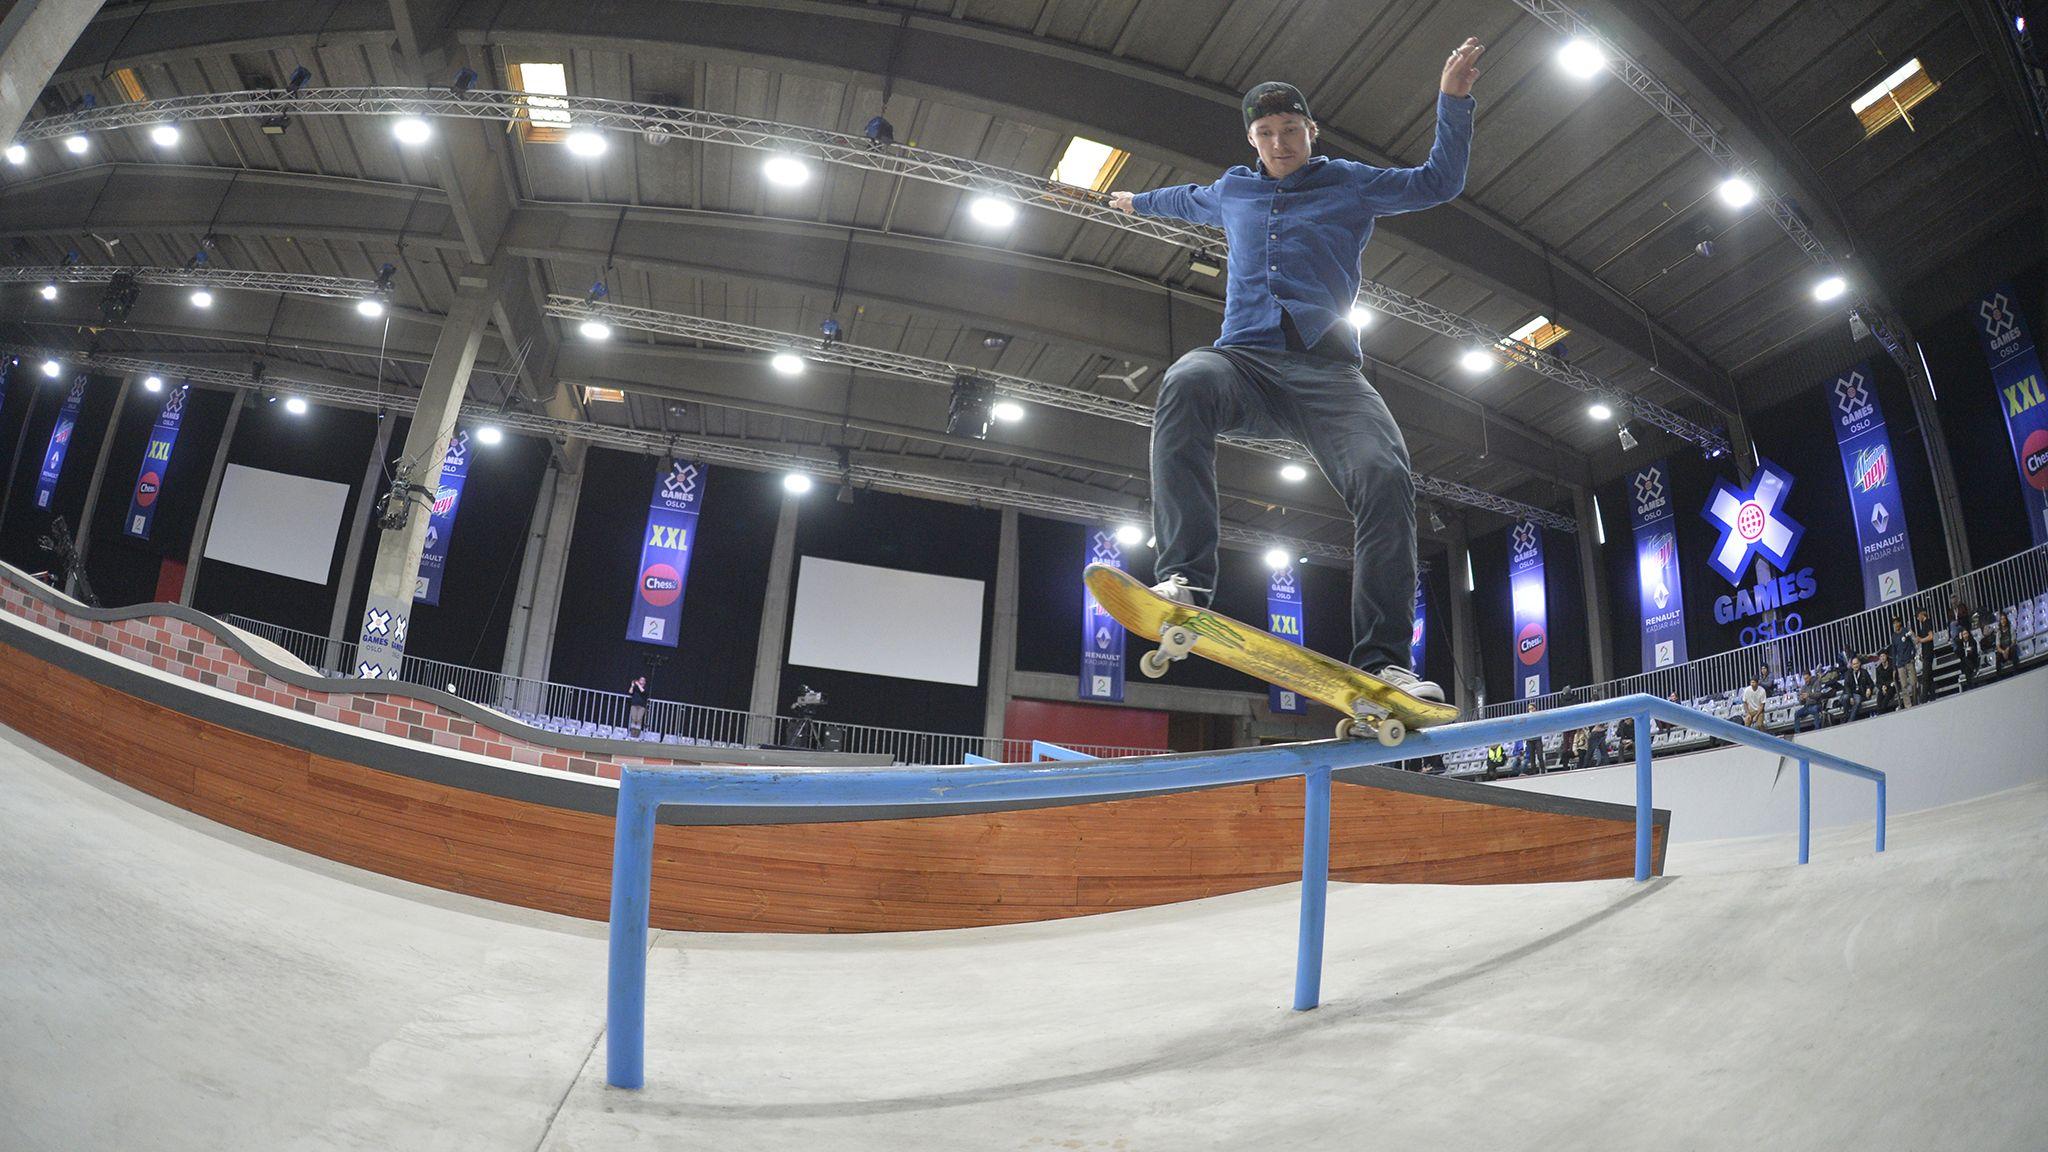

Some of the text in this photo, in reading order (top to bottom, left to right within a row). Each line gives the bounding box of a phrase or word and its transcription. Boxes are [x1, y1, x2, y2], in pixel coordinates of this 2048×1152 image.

[1990, 327, 2021, 350] GAMES
[2000, 343, 2019, 358] OSLO
[2003, 375, 2046, 417] XXL
[1841, 403, 1874, 426] GAMES
[1850, 419, 1871, 433] OSLO
[148, 440, 170, 461] XXL
[661, 490, 694, 502] GAMES
[665, 500, 686, 509] OSLO
[1637, 496, 1666, 514] GAMES
[1644, 509, 1662, 521] OSLO
[649, 524, 688, 551] XXL
[1864, 533, 1904, 554] RENAULT
[1514, 547, 1538, 563] GAMES
[1519, 559, 1534, 569] OSLO
[646, 578, 672, 589] Chess
[1271, 584, 1295, 594] GAMES
[1884, 575, 1897, 598] 2
[1276, 592, 1291, 600] OSLO
[1714, 567, 1817, 625] GAMES
[1270, 614, 1299, 635] XXL
[1645, 609, 1680, 626] RENAULT
[648, 620, 658, 635] 2
[1739, 612, 1803, 647] OSLO
[363, 635, 388, 646] GAMES
[366, 645, 382, 653] OSLO
[1085, 651, 1120, 661] RENAULT
[1660, 645, 1669, 663] 2
[1097, 678, 1106, 693] 2
[1529, 679, 1536, 694] 2
[1285, 694, 1292, 707] 2
